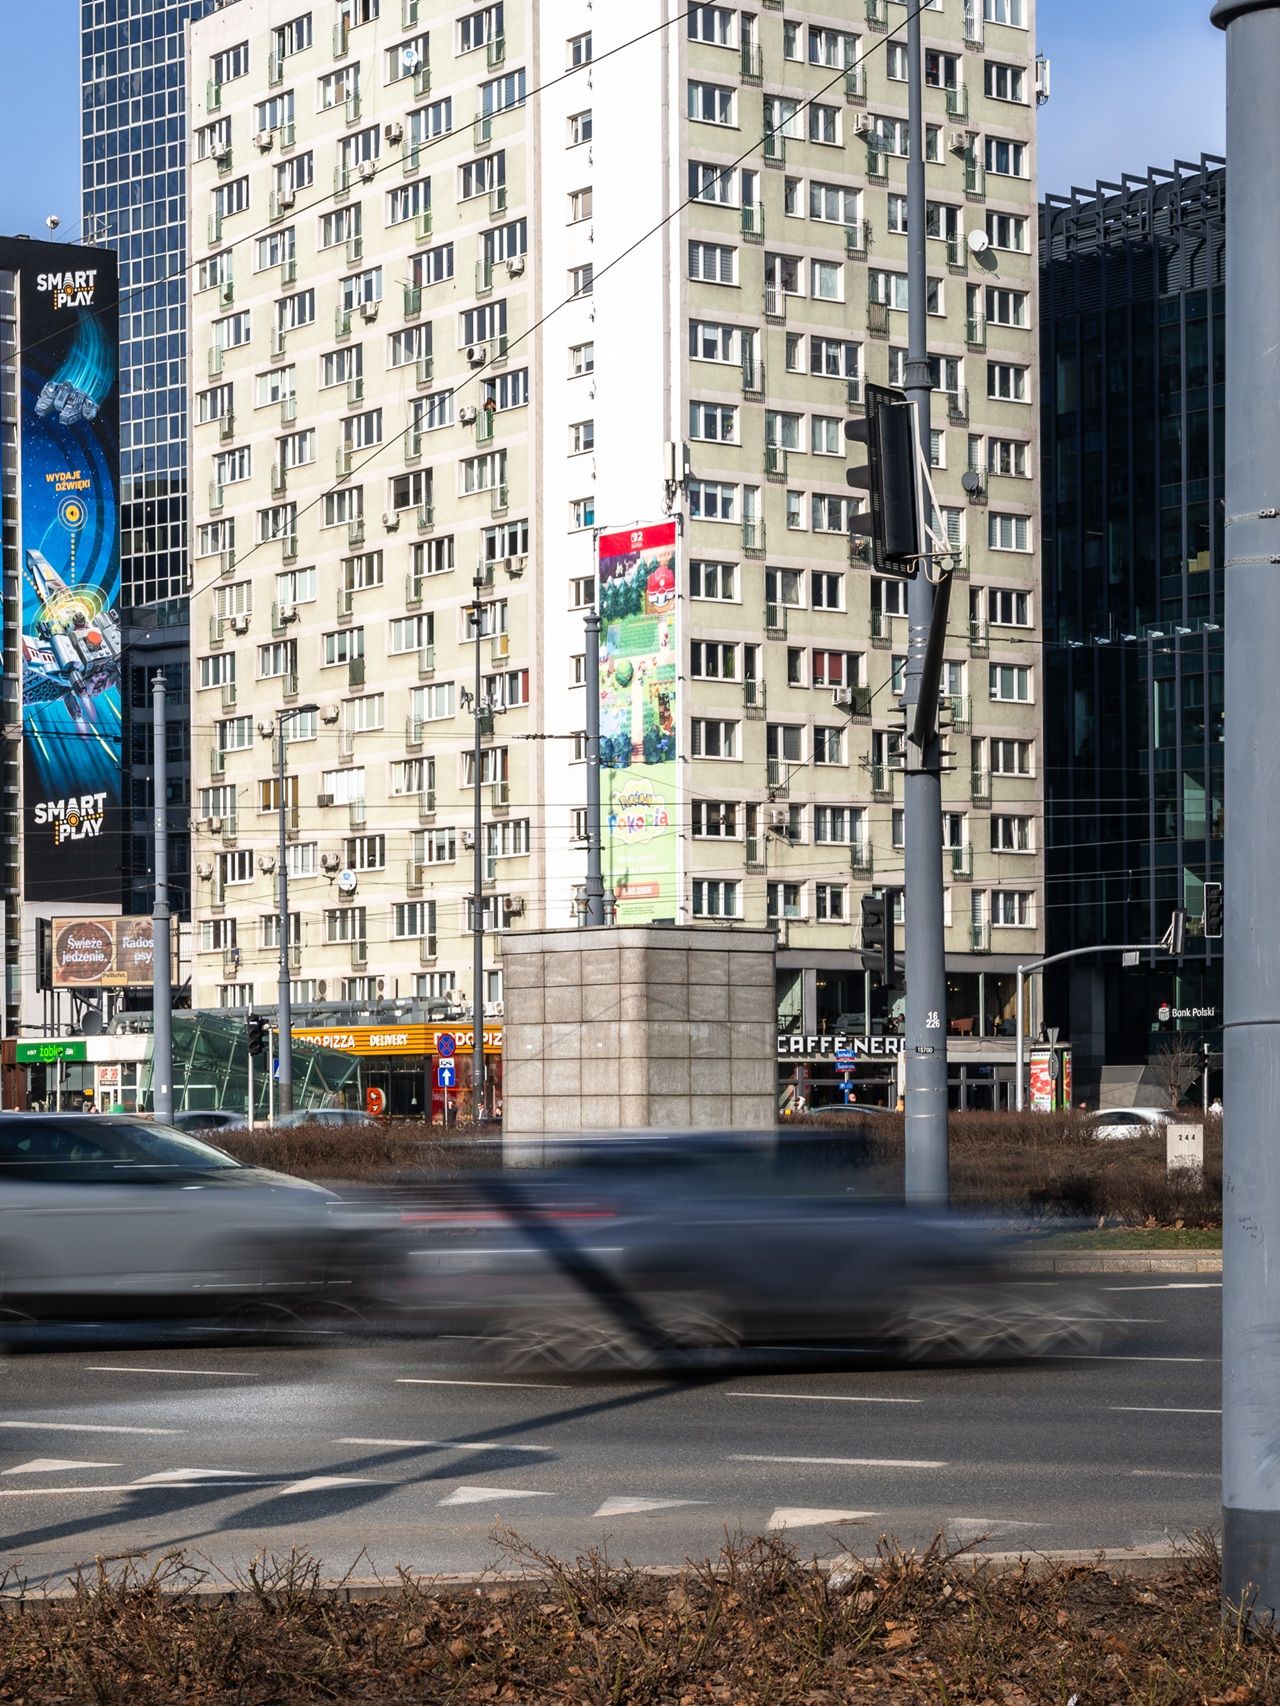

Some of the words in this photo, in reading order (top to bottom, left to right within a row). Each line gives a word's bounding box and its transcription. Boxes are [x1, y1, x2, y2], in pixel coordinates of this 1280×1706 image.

[37, 269, 97, 292] SMART
[57, 290, 94, 309] PLAY
[46, 470, 81, 482] WYDAJE
[55, 479, 91, 491] DŹWIĘKI
[34, 792, 107, 824] SMART
[59, 818, 104, 843] PLAY
[67, 935, 103, 950] Świeże
[122, 936, 154, 948] Rados
[62, 950, 108, 966] jedzenie.
[927, 1011, 938, 1020] 16
[1172, 1008, 1192, 1018] Bank
[1192, 1006, 1216, 1017] Polski
[926, 1019, 940, 1028] 226
[323, 1035, 356, 1048] PIZZA
[369, 1033, 409, 1047] DELIVERY
